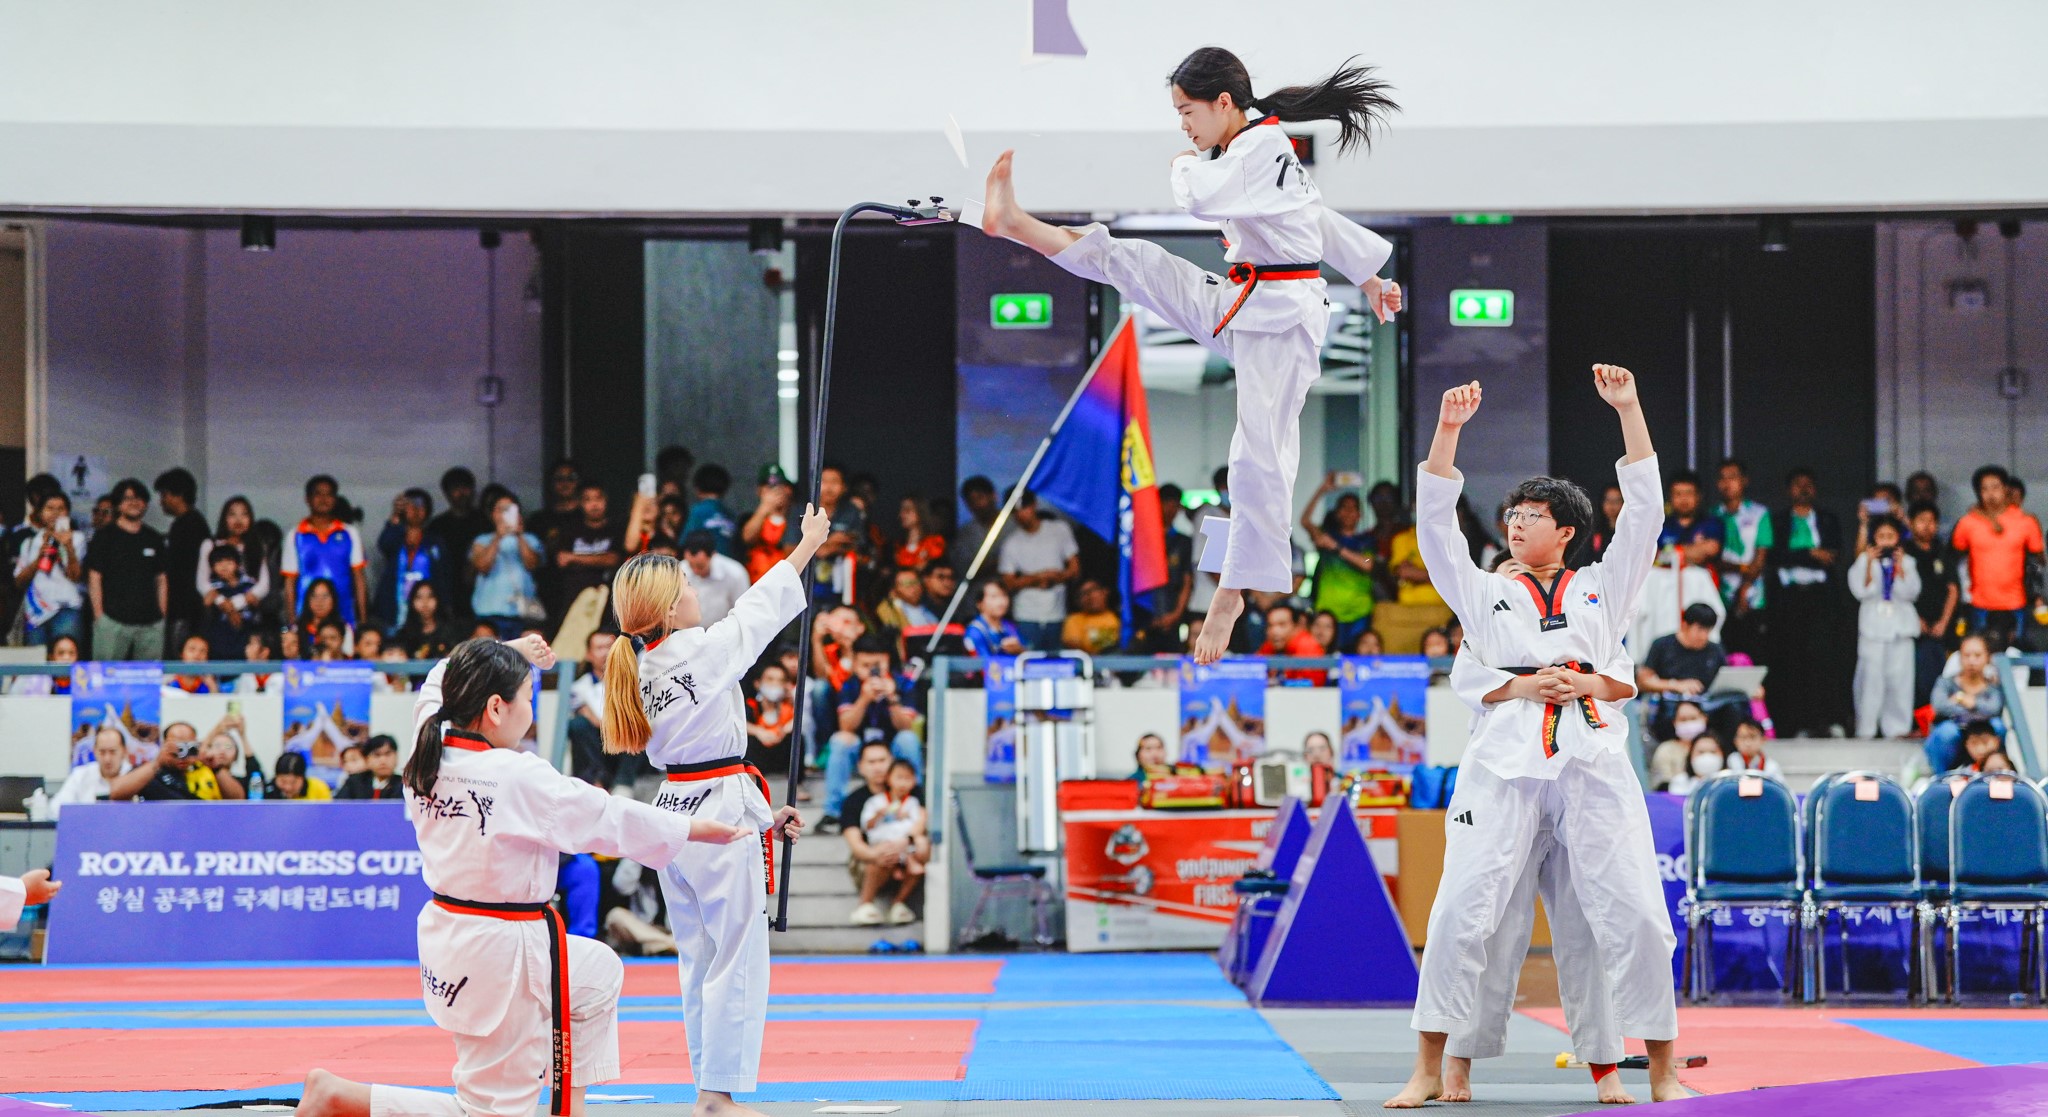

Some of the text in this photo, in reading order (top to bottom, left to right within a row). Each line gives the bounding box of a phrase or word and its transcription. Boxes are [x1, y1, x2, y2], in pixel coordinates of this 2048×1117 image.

[457, 777, 499, 788] TAEKWONDO
[78, 850, 423, 877] ROYAL PRINCESS CUP
[97, 884, 401, 913] 왕실 공주컵 국제태권도대회
